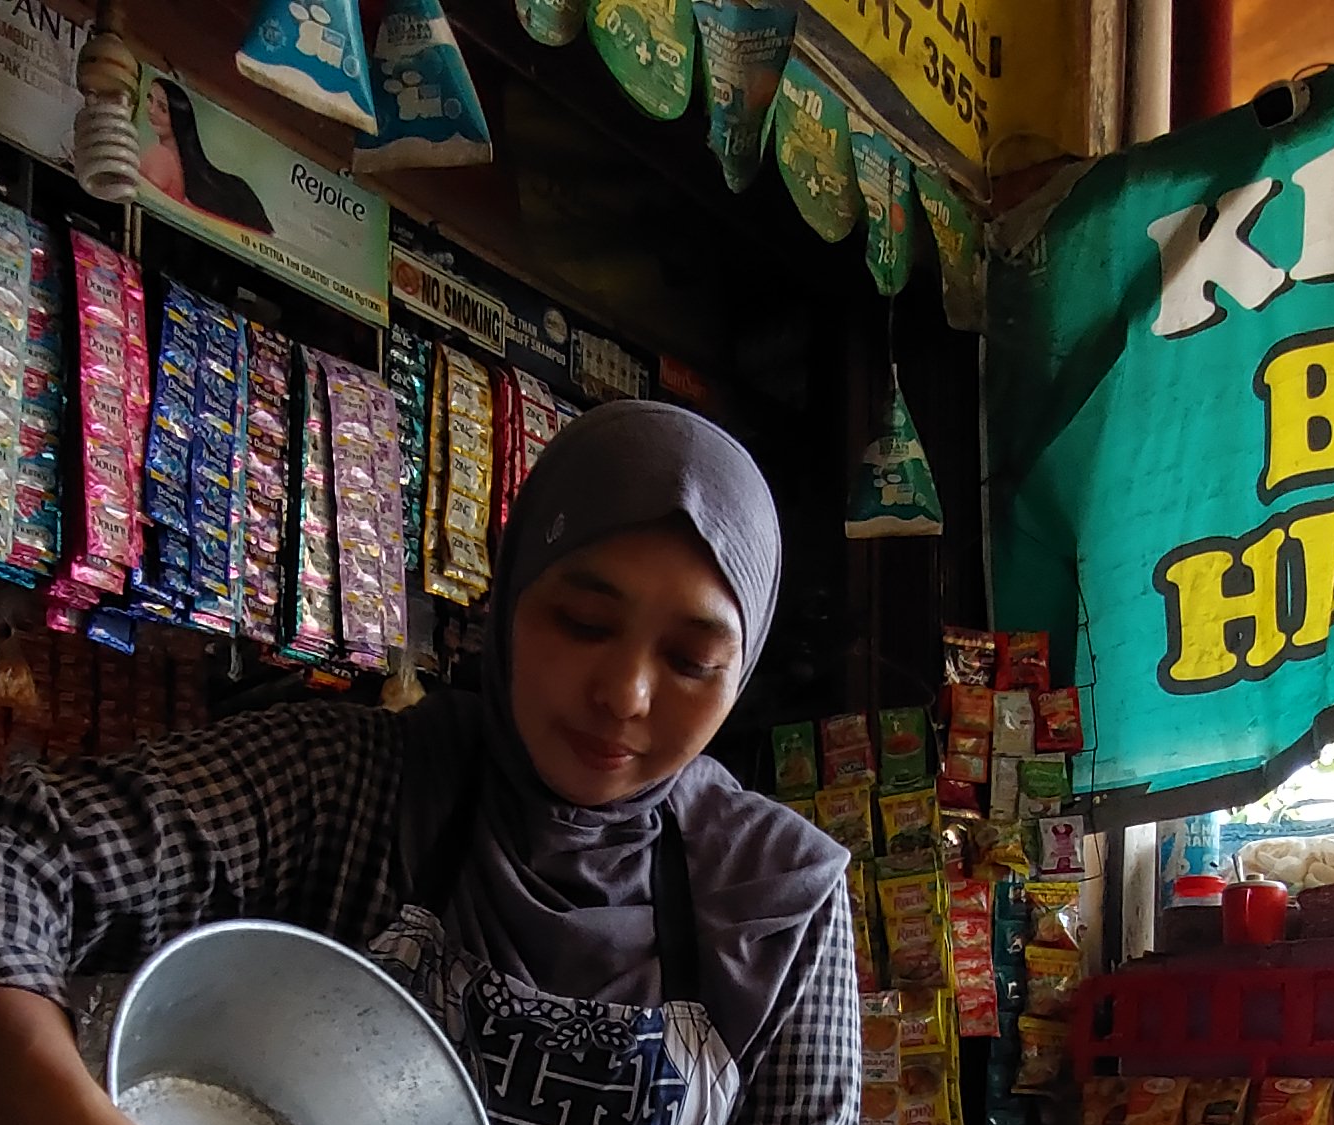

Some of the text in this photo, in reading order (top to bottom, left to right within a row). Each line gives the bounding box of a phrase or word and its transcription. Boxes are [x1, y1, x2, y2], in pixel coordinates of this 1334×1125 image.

[290, 163, 366, 222] Rejoice
[421, 270, 502, 342] NO SMOKING
